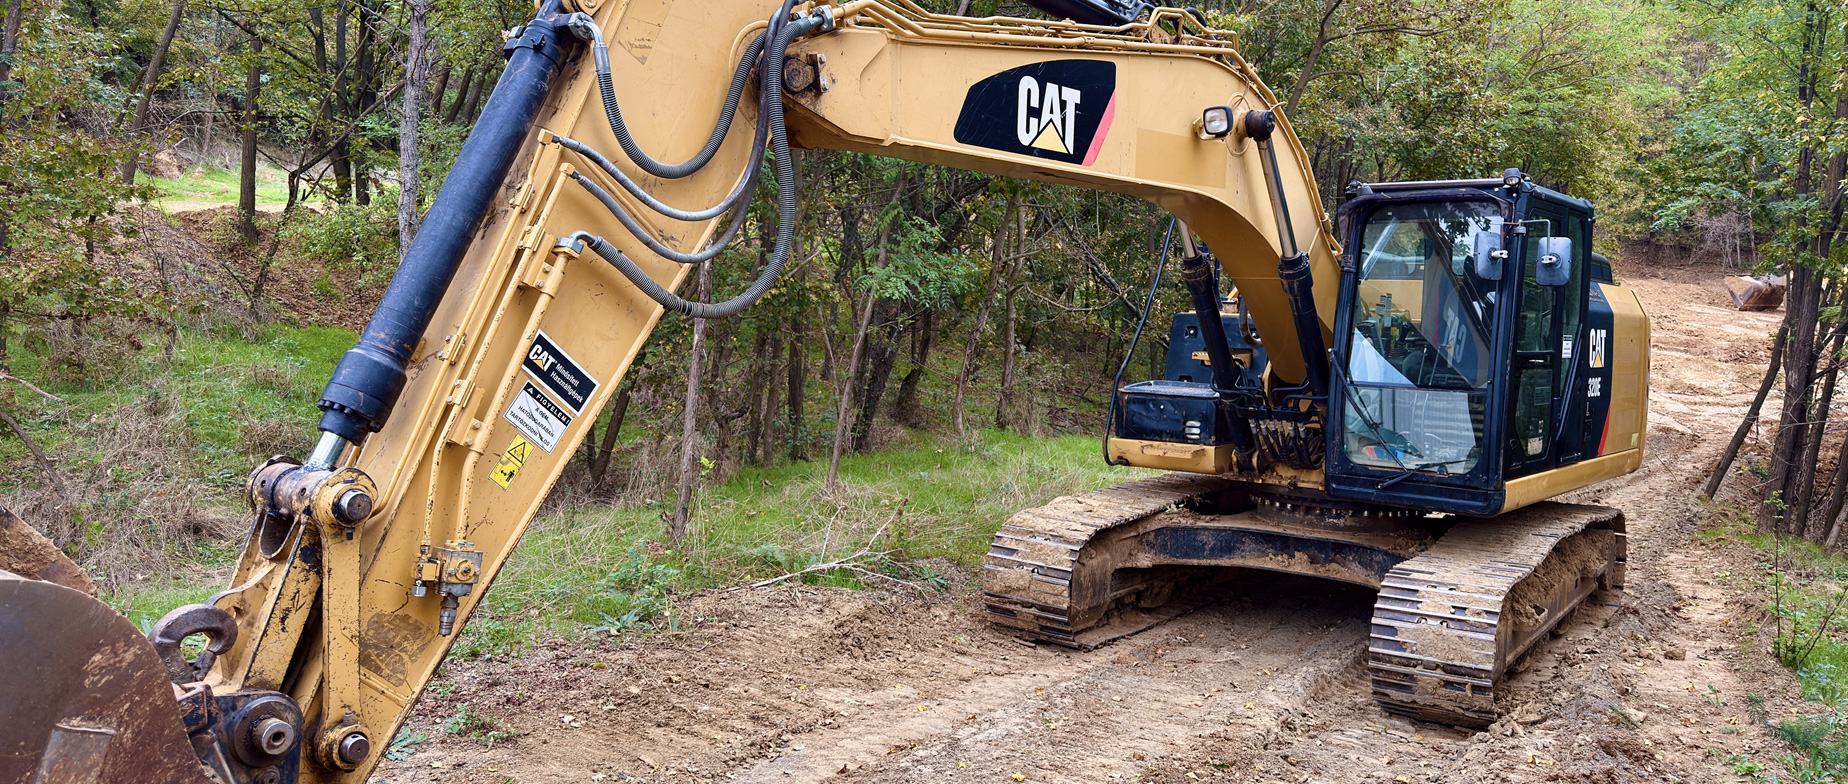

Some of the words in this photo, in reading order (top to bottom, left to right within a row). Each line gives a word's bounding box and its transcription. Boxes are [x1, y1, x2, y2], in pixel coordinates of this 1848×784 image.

[1017, 75, 1081, 155] CAT
[528, 344, 557, 372] CAT
[1589, 328, 1607, 368] CAT
[550, 371, 583, 403] Használtgépek
[555, 363, 580, 387] Minősített
[1587, 377, 1602, 397] 320E
